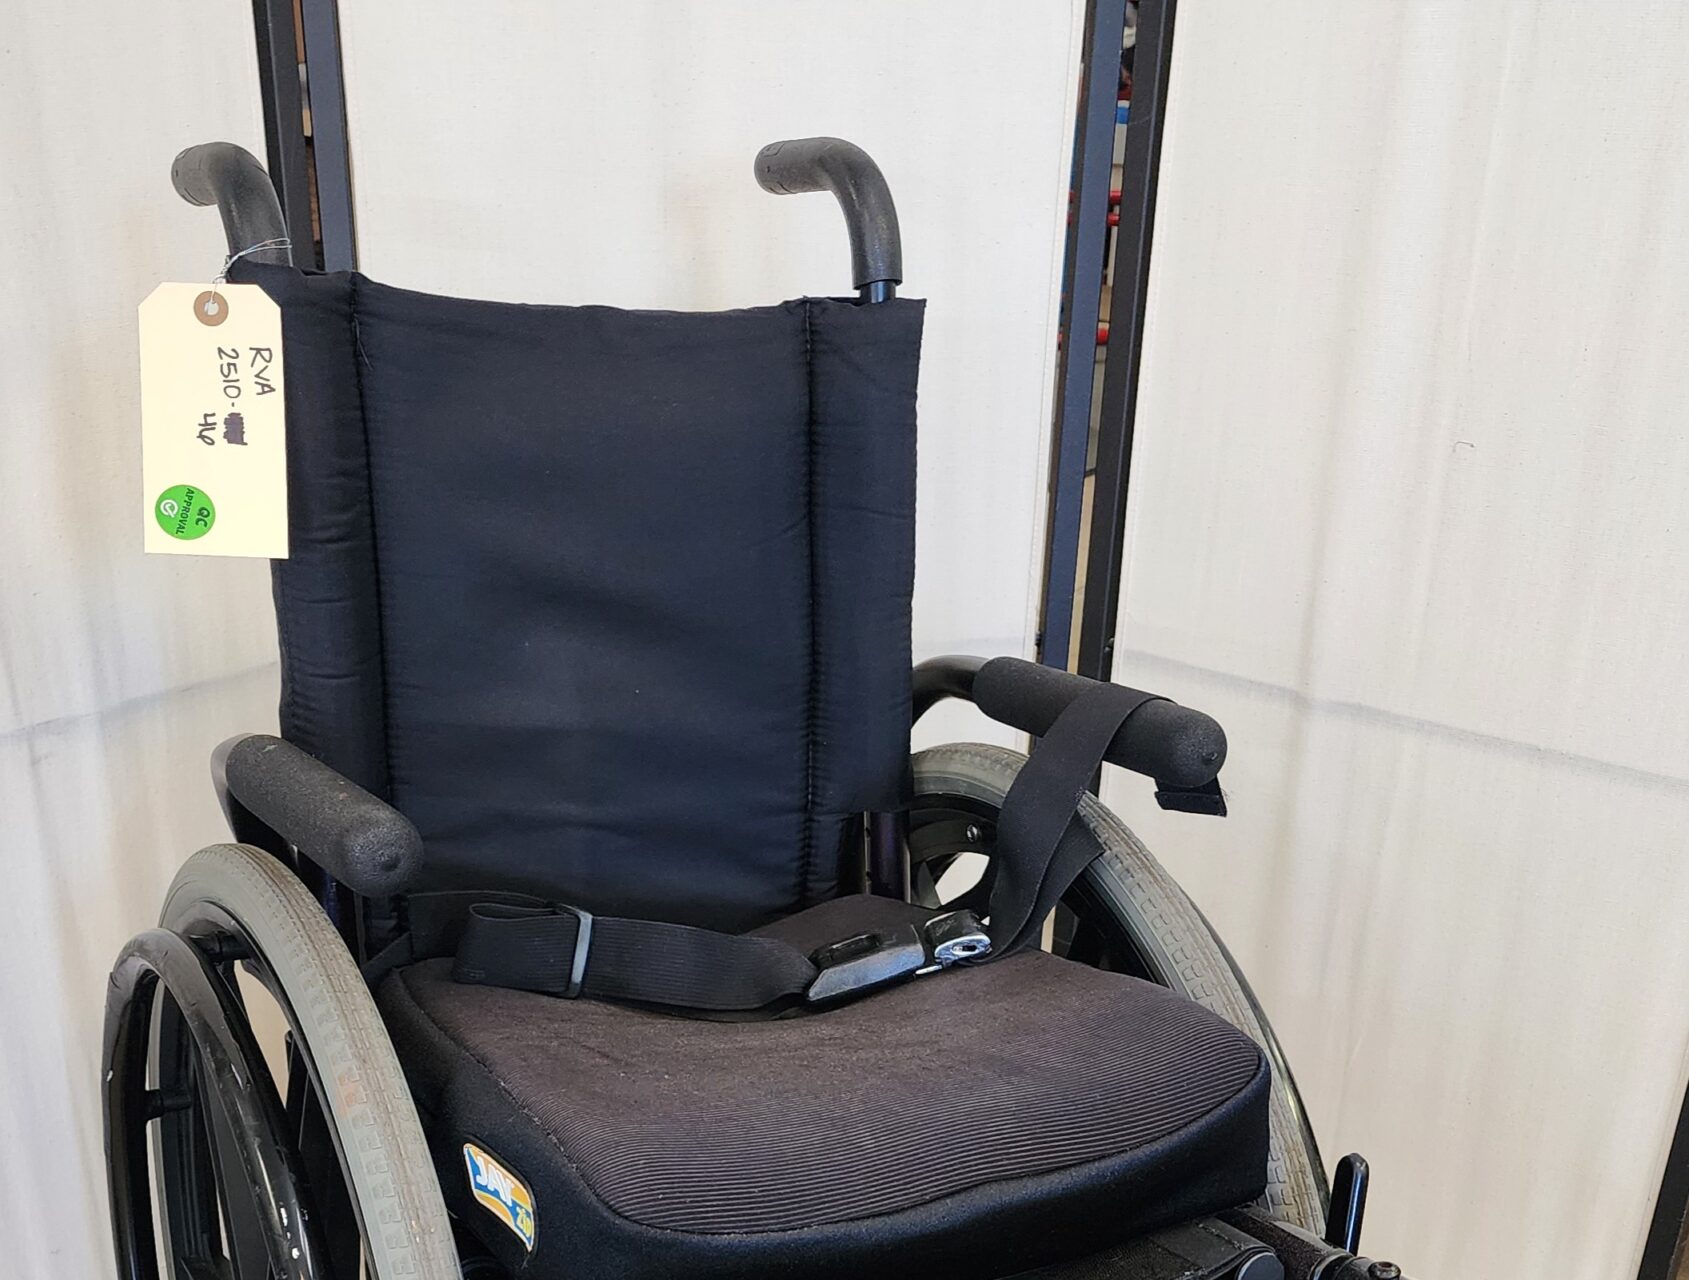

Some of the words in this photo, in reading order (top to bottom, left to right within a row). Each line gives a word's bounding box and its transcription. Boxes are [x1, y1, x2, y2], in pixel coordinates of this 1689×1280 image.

[249, 347, 276, 395] RVA
[175, 487, 195, 535] APPROVAL
[195, 506, 210, 528] QC
[475, 1155, 515, 1207] JAY
